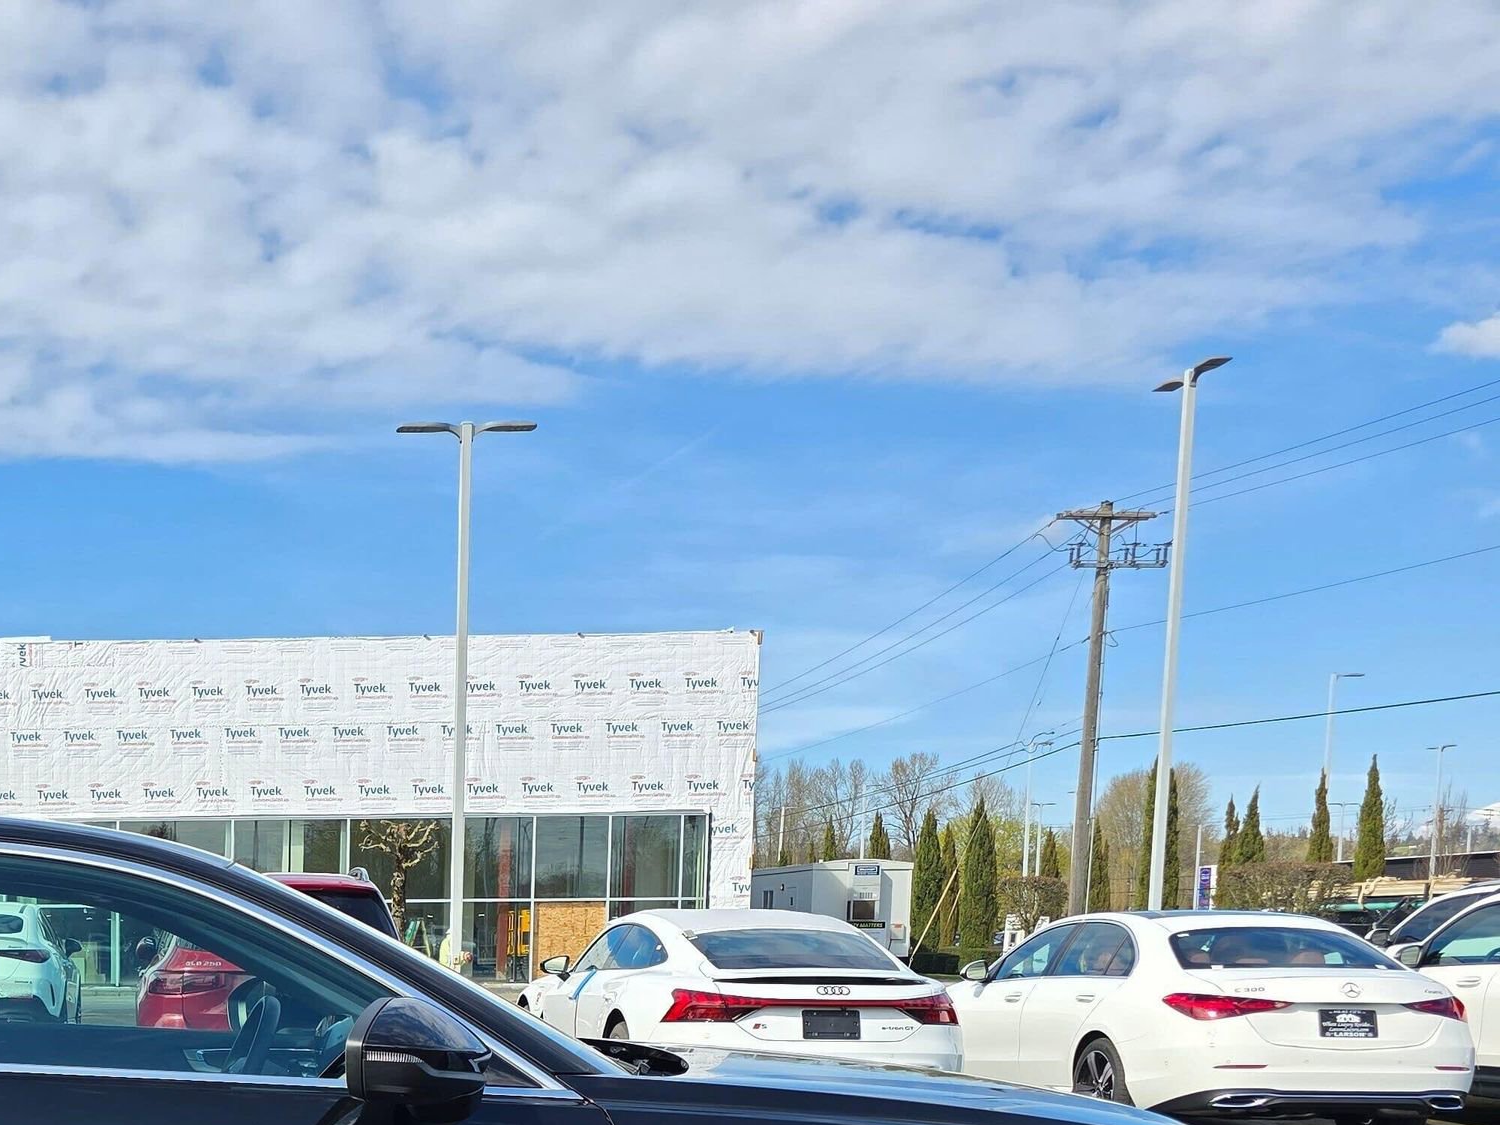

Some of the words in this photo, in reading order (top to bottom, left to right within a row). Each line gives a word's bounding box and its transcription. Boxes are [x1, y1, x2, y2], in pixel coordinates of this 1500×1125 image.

[353, 682, 386, 695] Tyvek
[408, 681, 441, 695] Tyvek
[518, 680, 551, 693] Tyvek
[573, 678, 606, 691] Tyvek
[629, 678, 662, 691] Tyvek
[684, 677, 717, 690] Tyvek
[741, 676, 759, 689] Tyv
[31, 689, 63, 702] Tyvek
[84, 688, 117, 701] Tyvek
[137, 687, 170, 700] Tyvek
[191, 686, 223, 699] Tyvek
[245, 685, 278, 698] Tyvek
[299, 683, 331, 697] Tyvek
[332, 726, 364, 739] Tyvek
[386, 725, 418, 738] Tyvek
[495, 723, 528, 736] Tyvek
[550, 722, 583, 736] Tyvek
[605, 721, 638, 735] Tyvek
[661, 721, 693, 734] Tyvek
[716, 720, 749, 733] Tyvek
[10, 731, 42, 744] Tyvek
[63, 730, 95, 743] Tyvek
[116, 729, 148, 742] Tyvek
[169, 728, 201, 741] Tyvek
[224, 727, 256, 740] Tyvek
[277, 727, 310, 740] Tyvek
[250, 785, 282, 798] Tyvek
[304, 785, 336, 798] Tyvek
[358, 784, 390, 797] Tyvek
[412, 783, 444, 796] Tyvek
[468, 783, 500, 796] Tyvek
[521, 782, 553, 795] Tyvek
[576, 781, 610, 794] Tyvek
[632, 781, 665, 794] Tyvek
[686, 779, 719, 793] Tyvek
[37, 789, 69, 802] Tyvek
[89, 788, 121, 801] Tyvek
[143, 787, 175, 800] Tyvek
[196, 786, 228, 800] Tyvek
[711, 823, 738, 836] yvek
[732, 882, 751, 894] Tyv
